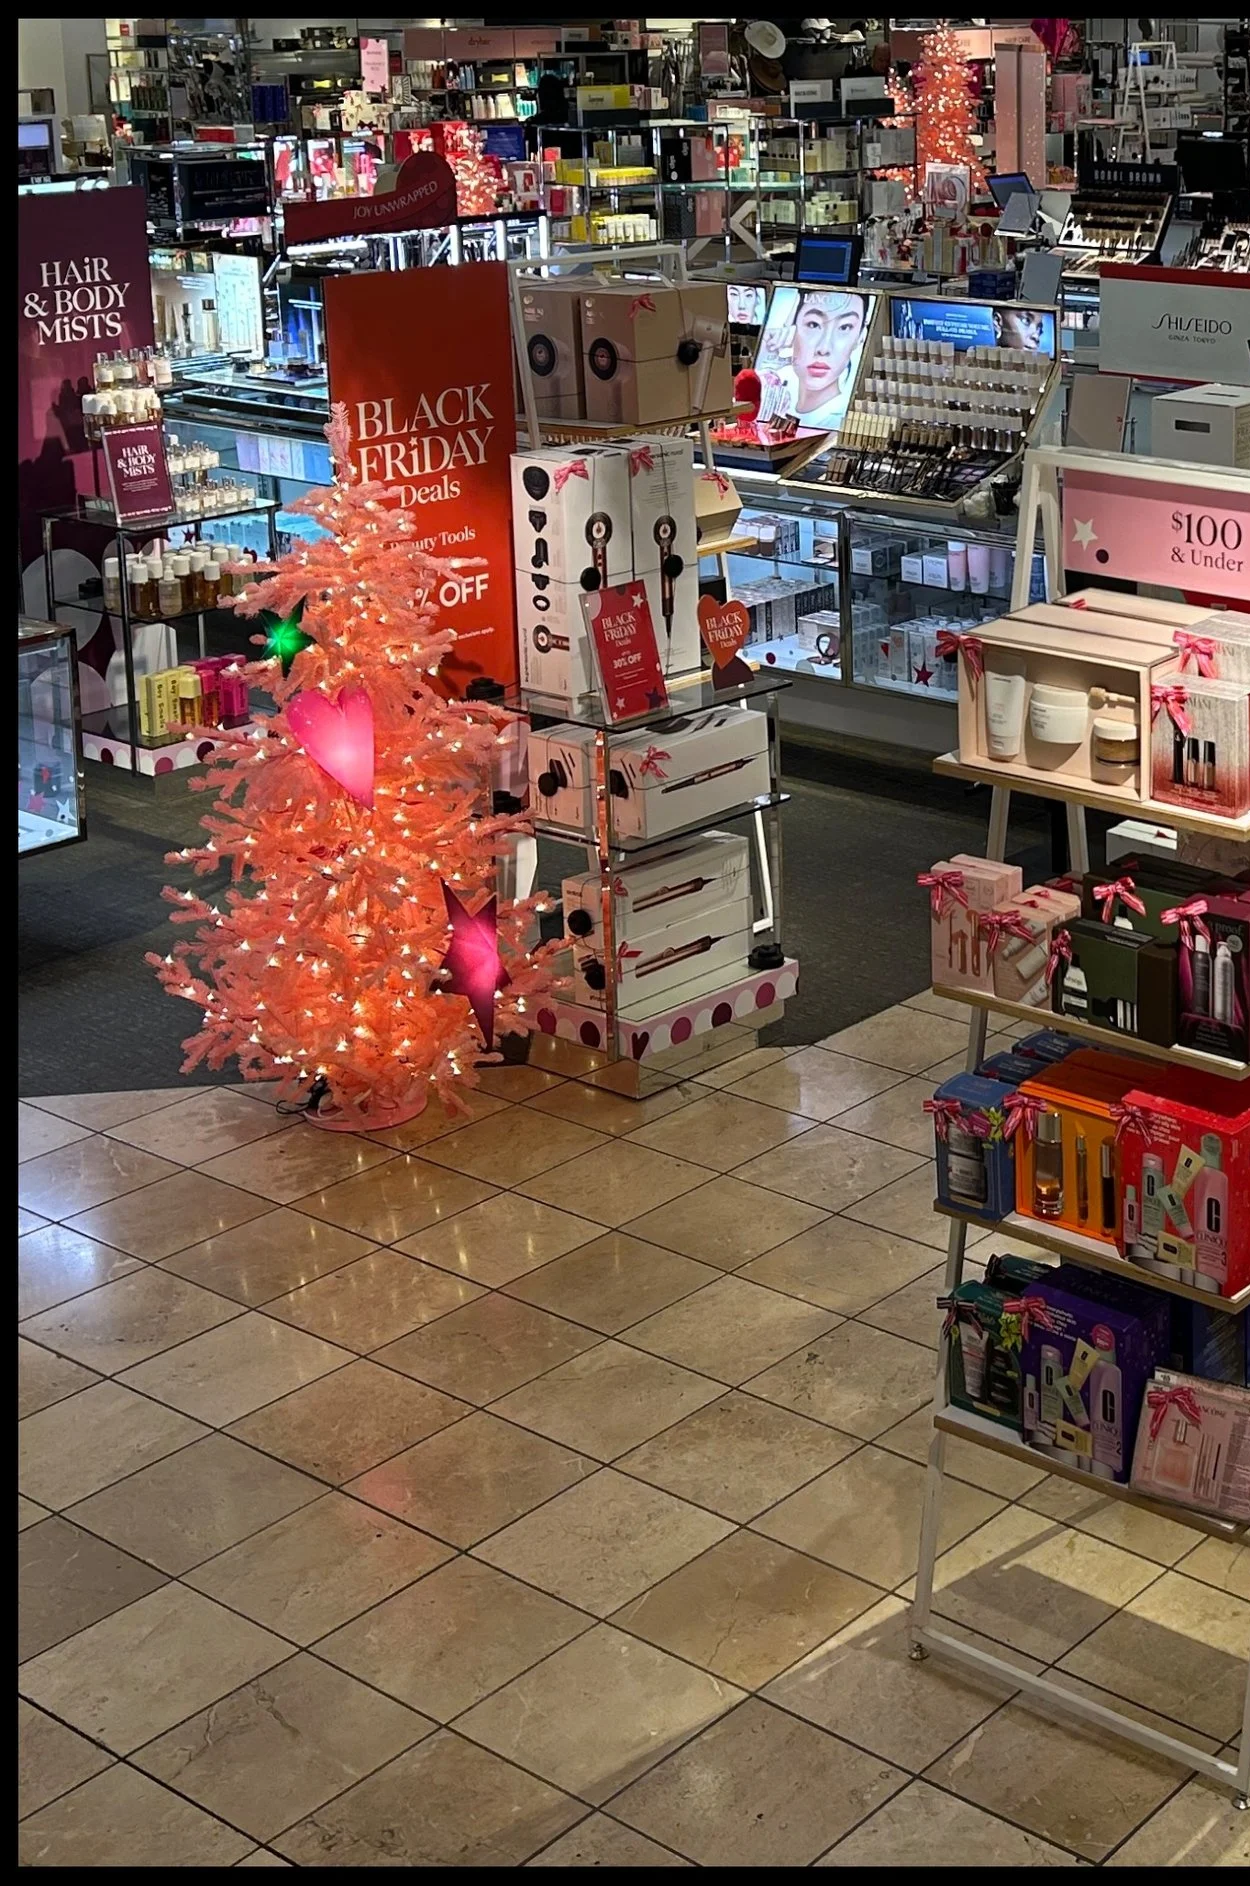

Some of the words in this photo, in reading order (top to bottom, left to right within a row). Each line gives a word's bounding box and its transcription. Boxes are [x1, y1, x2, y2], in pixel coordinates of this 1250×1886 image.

[1129, 171, 1161, 183] BROWN
[353, 205, 372, 219] JOY
[374, 181, 438, 216] UNWRAPPED
[23, 292, 49, 318] &
[54, 282, 130, 315] BODY
[1152, 313, 1232, 335] SHISEIDO
[356, 383, 494, 441] BLACK
[117, 458, 127, 469] &
[128, 453, 156, 466] BODY
[400, 474, 461, 508] Deals
[391, 532, 437, 551] Buty
[438, 526, 476, 546] Tools
[1171, 510, 1242, 550] $100
[1171, 546, 1185, 563] &
[1191, 549, 1243, 572] Under
[439, 573, 490, 607] OFF
[601, 611, 636, 630] BLACK
[706, 611, 743, 630] BLACK
[628, 652, 642, 664] OFF
